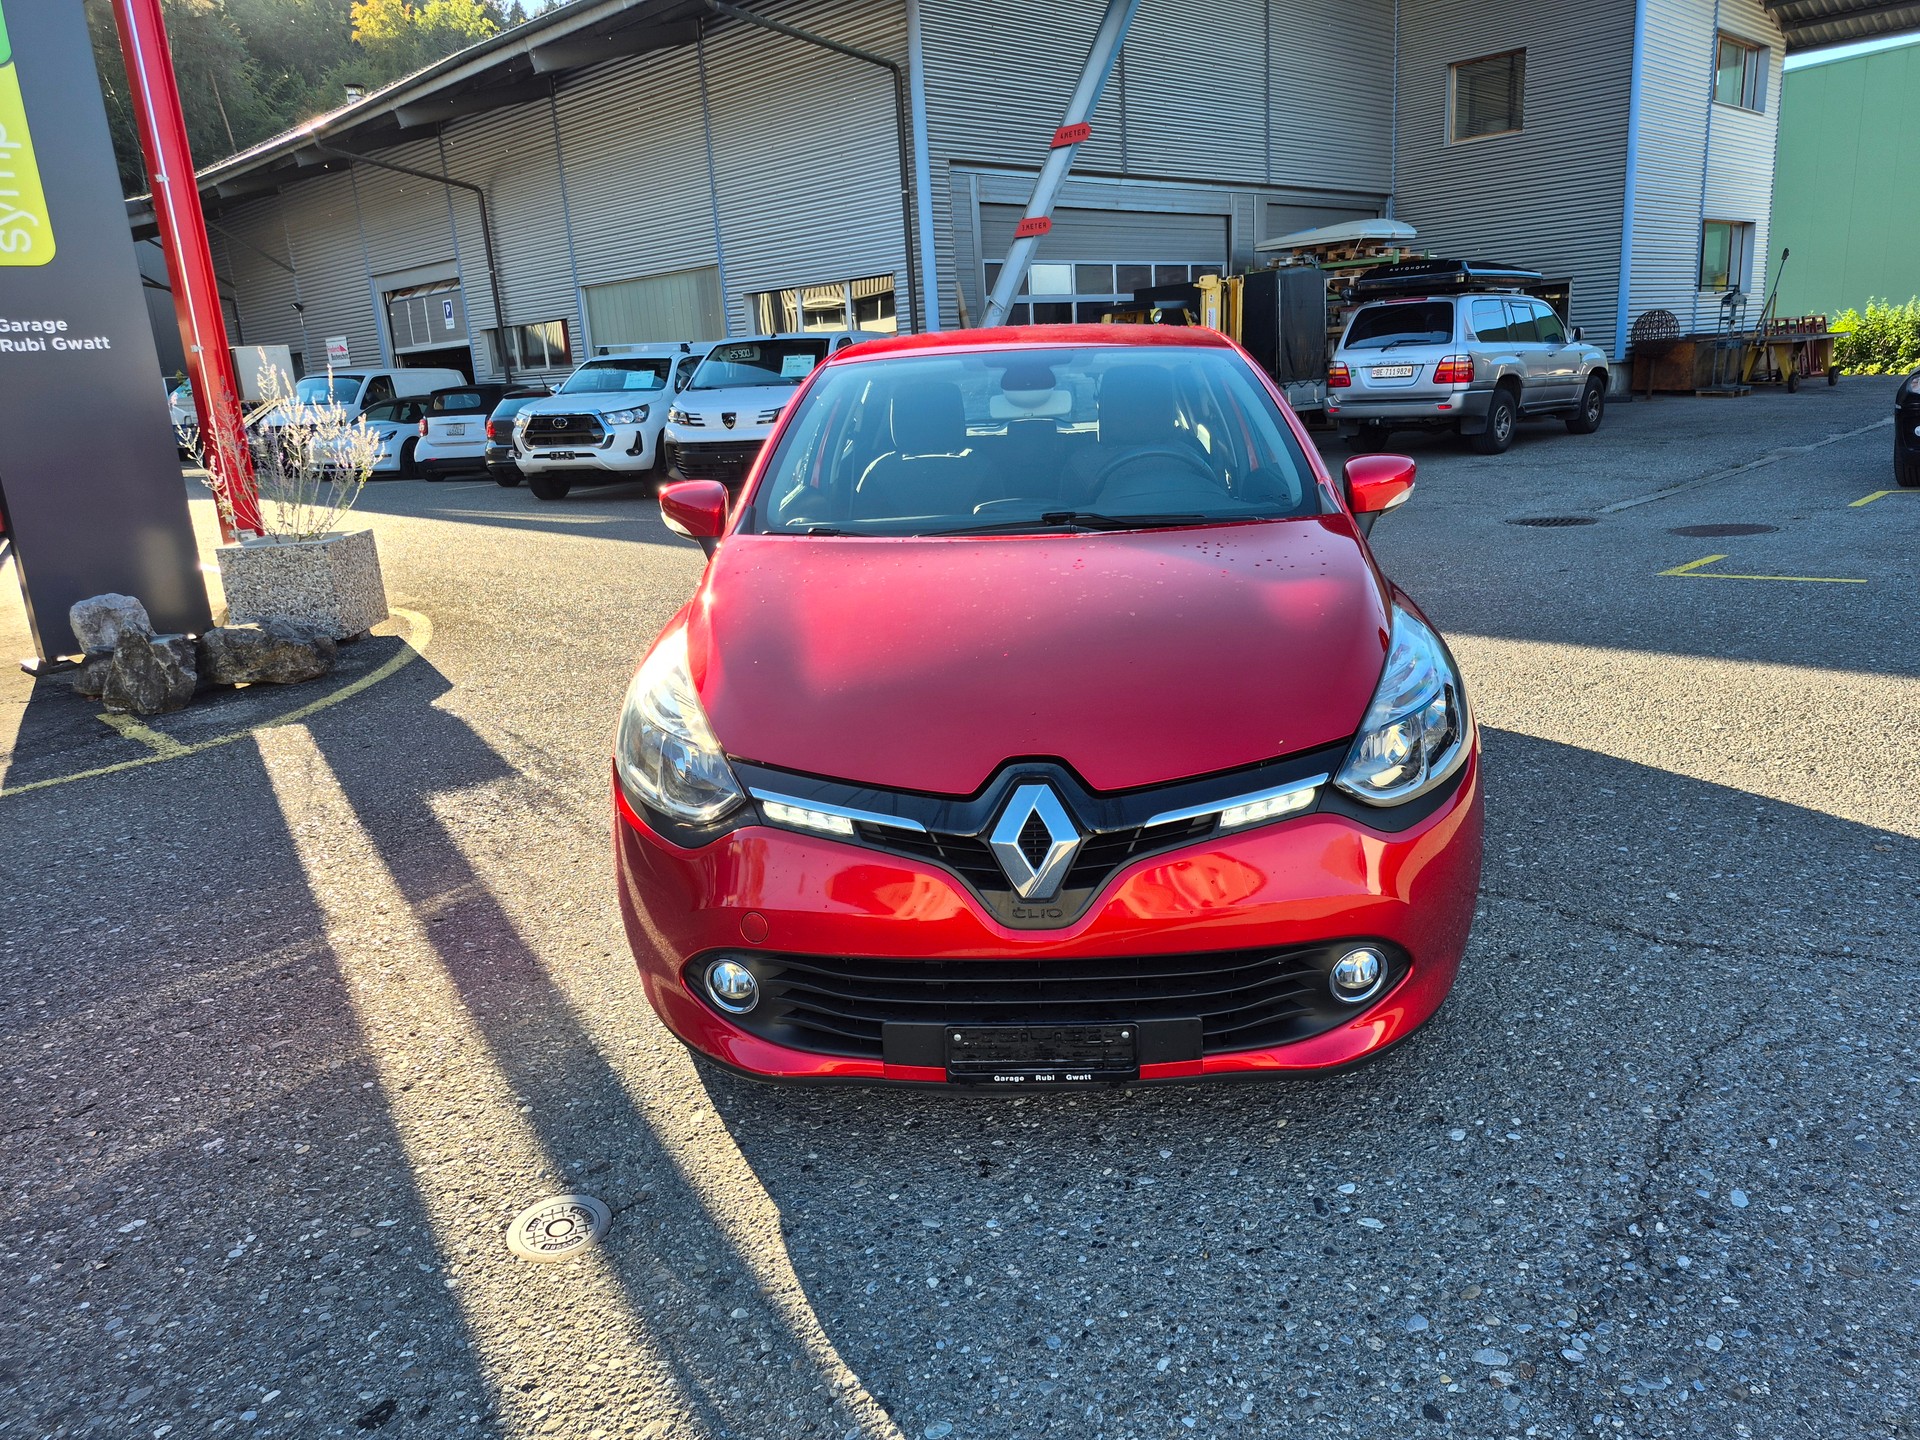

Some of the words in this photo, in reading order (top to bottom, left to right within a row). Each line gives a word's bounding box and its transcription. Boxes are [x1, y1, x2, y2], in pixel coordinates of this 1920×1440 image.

[0, 319, 68, 334] Garage
[0, 338, 47, 352] Rubi
[52, 336, 111, 351] Gwatt
[1012, 908, 1063, 919] CLIO
[993, 1075, 1025, 1083] Garage
[1065, 1073, 1092, 1081] Gwatt
